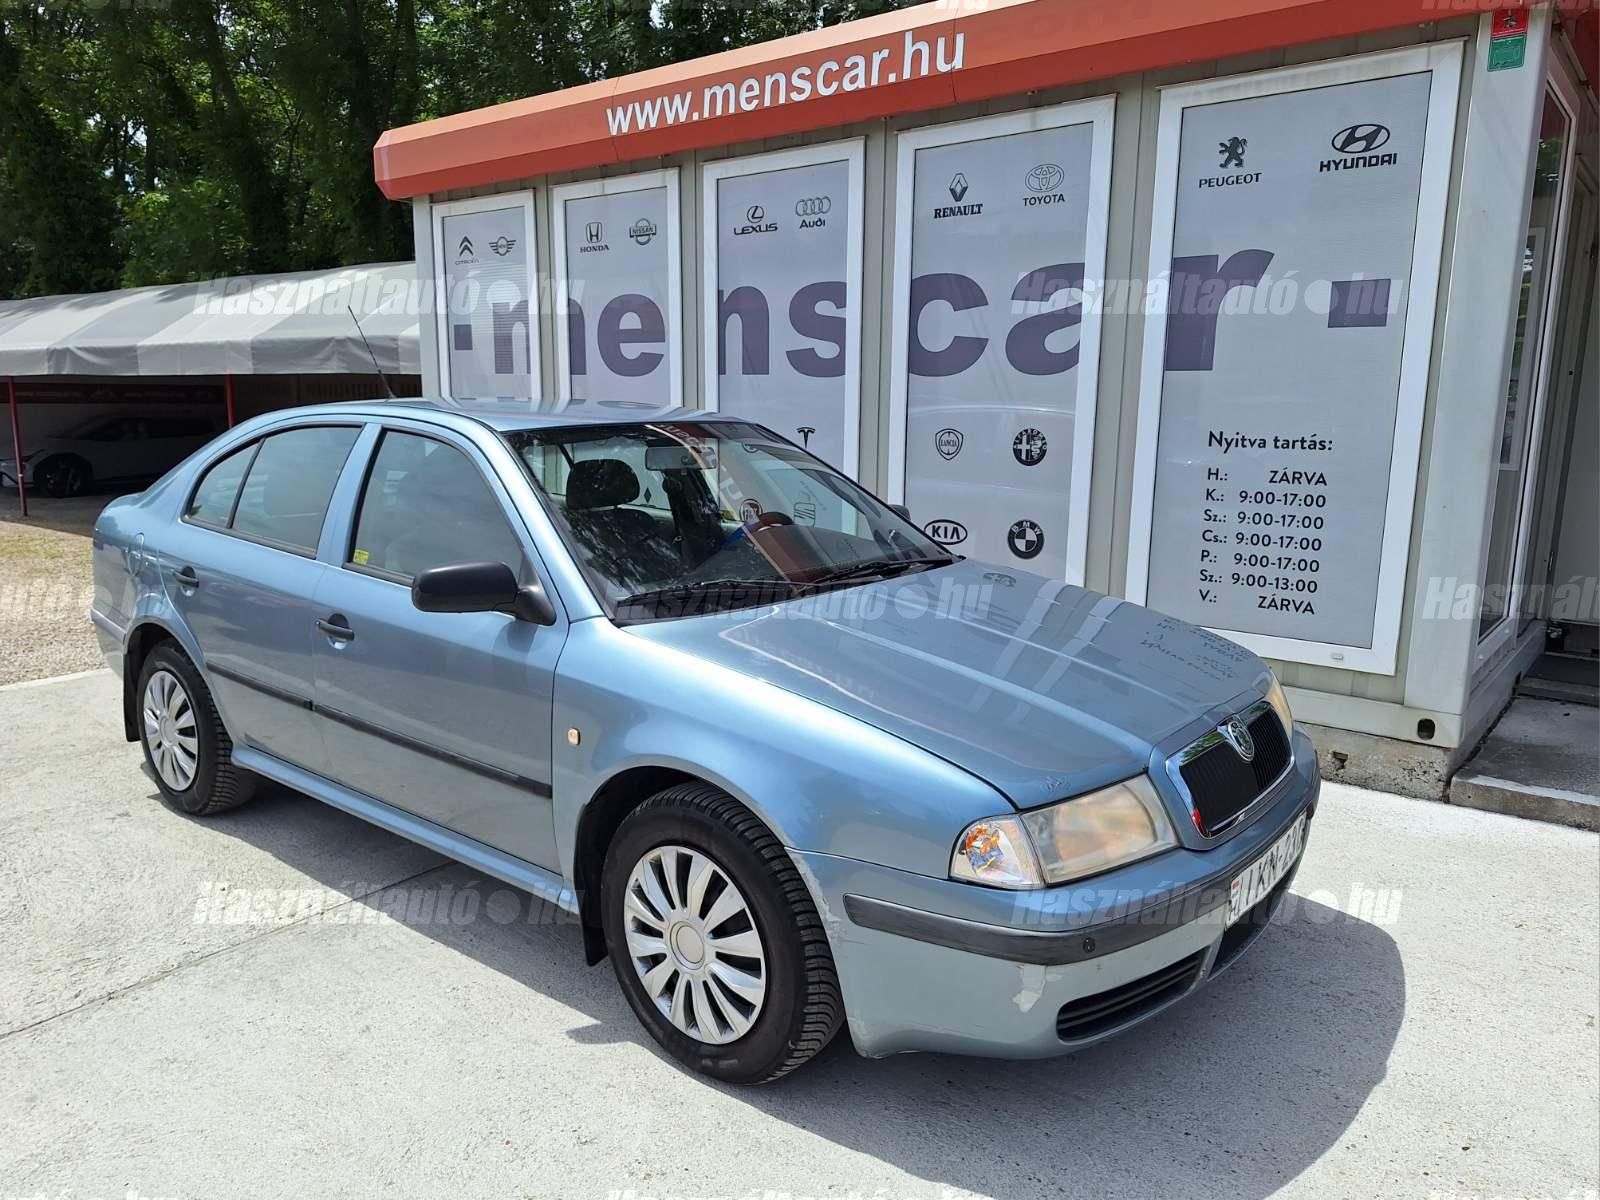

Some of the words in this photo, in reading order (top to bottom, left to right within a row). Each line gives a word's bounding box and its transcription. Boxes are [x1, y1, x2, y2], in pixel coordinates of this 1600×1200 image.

[606, 31, 964, 136] www.menscar.hu
[1319, 153, 1397, 172] HYUNDAI
[1199, 172, 1262, 188] PEUGEOT
[1023, 193, 1065, 207] TOYOTA
[934, 203, 983, 219] RENAULT
[632, 226, 654, 235] NISSAN
[734, 223, 778, 235] LEXUS
[799, 218, 826, 229] Audi
[580, 244, 610, 253] HONDA
[1208, 430, 1267, 454] Nyitva
[1273, 433, 1333, 451] tartás:
[1207, 467, 1228, 481] H.:
[1268, 466, 1327, 486] ZÁRVA
[1206, 488, 1225, 502] K.:
[1239, 490, 1327, 508] 9:00-17:00
[1011, 521, 1042, 536] BMW
[1203, 508, 1227, 523] Sz.:
[1237, 511, 1324, 530] 9:00-17:00
[931, 524, 960, 540] KIA
[1202, 529, 1228, 543] Cs.:
[1235, 531, 1322, 551] 9:00-17:00
[1200, 549, 1217, 563] P.:
[1233, 552, 1320, 573] 9:00-17:00
[1199, 569, 1222, 583] Sz.:
[1231, 572, 1318, 593] 9:00-13:00
[1199, 588, 1217, 603] V.:
[1257, 593, 1315, 615] ZÁRVA
